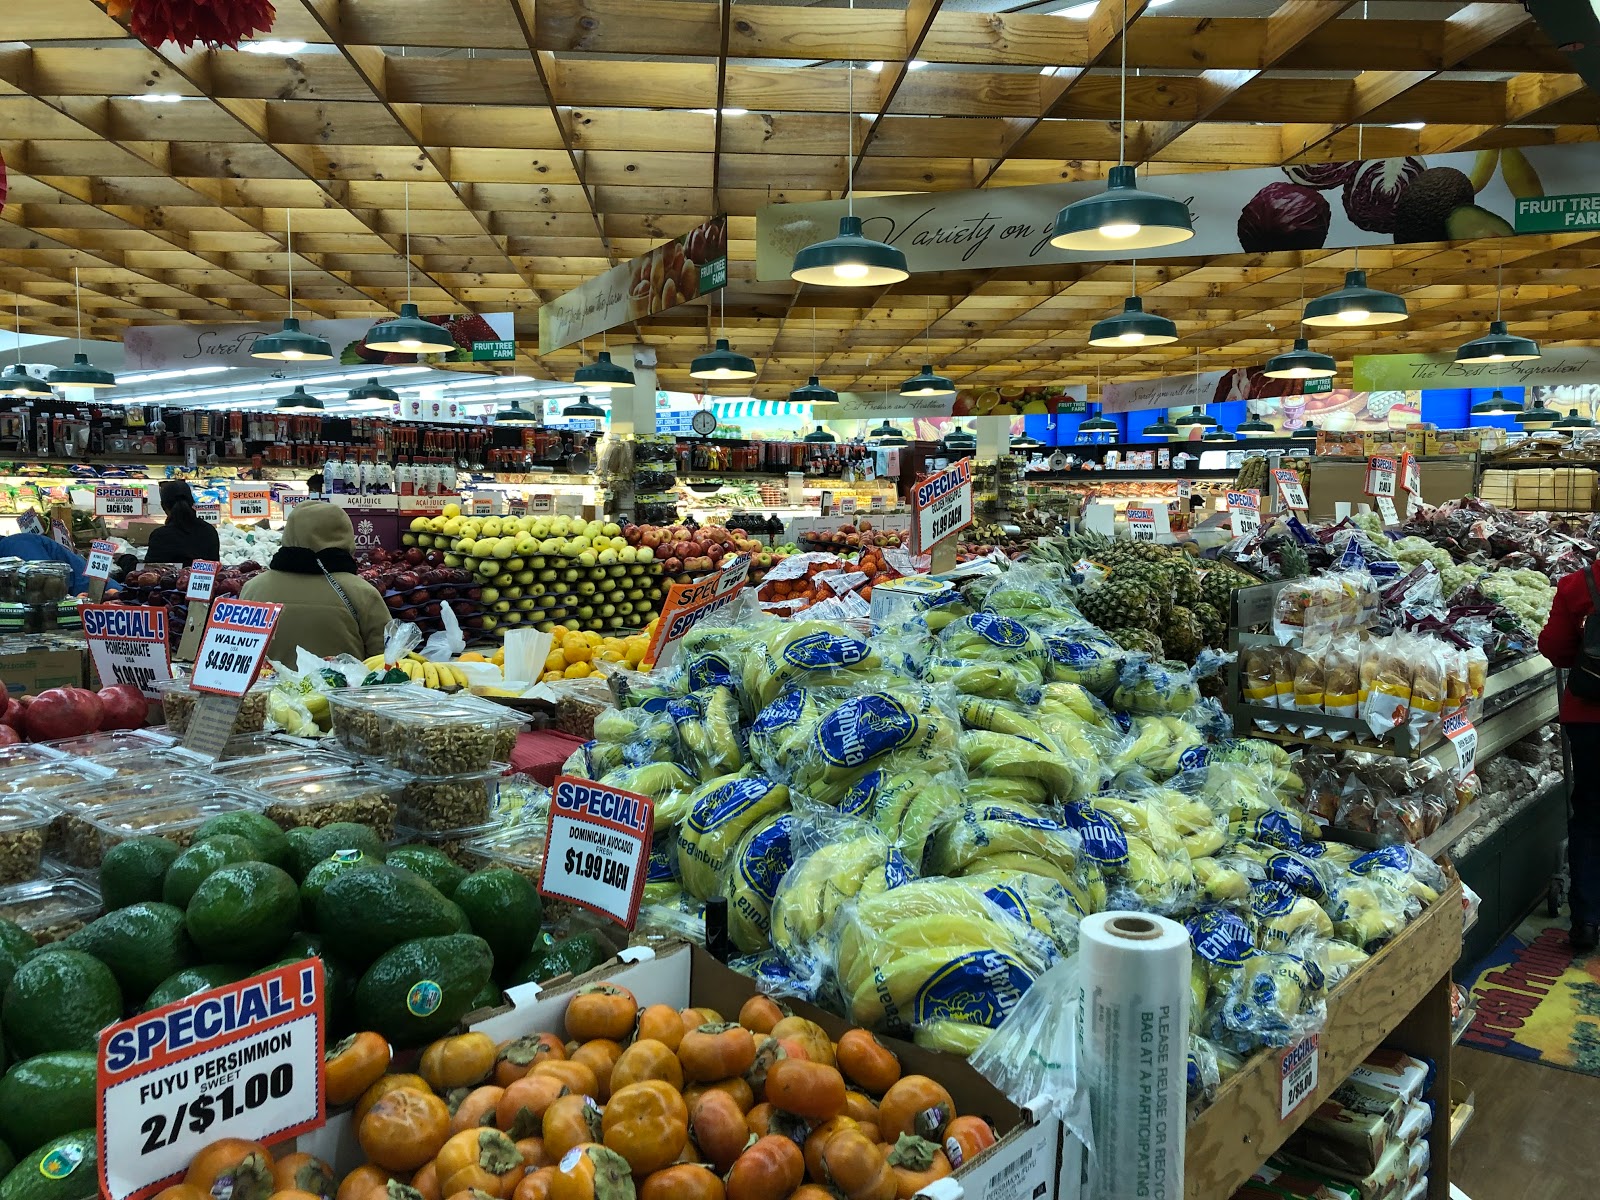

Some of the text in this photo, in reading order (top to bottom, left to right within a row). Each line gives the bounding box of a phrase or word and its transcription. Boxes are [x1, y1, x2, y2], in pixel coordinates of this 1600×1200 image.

[1520, 196, 1600, 215] FRUIT TRE
[1565, 210, 1600, 226] FAR
[1000, 221, 1036, 240] on
[701, 259, 726, 279] FRUIT TREE
[712, 273, 726, 286] FARM
[474, 341, 513, 351] FRUIT TREE
[493, 350, 513, 358] FARM
[1409, 362, 1437, 379] The
[97, 488, 142, 497] SPECIAL!
[232, 491, 267, 499] SPECIAL
[917, 461, 971, 507] SPECIAL!
[363, 497, 381, 505] JUICE
[932, 505, 962, 539] $1.99 EACH
[354, 535, 381, 545] ZOLA
[91, 561, 109, 572] $3.99
[677, 578, 719, 605] SPEC
[83, 609, 165, 640] SPECIAL!
[213, 602, 276, 629] SPECIAL!
[105, 640, 151, 658] POMEGRANATE
[214, 633, 260, 649] WALNUT
[205, 649, 253, 675] $4.99 PKG
[556, 781, 649, 833] SPECIAL!
[569, 826, 634, 855] DOMINICAN AVOCADOS
[595, 846, 613, 856] FRESH
[564, 847, 630, 891] $1.99 EACH
[106, 966, 316, 1074] SPECIAL!
[1282, 1033, 1319, 1075] SPECIAL!
[140, 1031, 292, 1105] FUYU PERSIMMON
[200, 1069, 242, 1093] SWEET
[140, 1062, 293, 1156] 2/$1.00
[1137, 1012, 1154, 1198] BAG AT A PARTICIPATING
[1154, 1005, 1170, 1200] PLEASE REUSE OR RECYC
